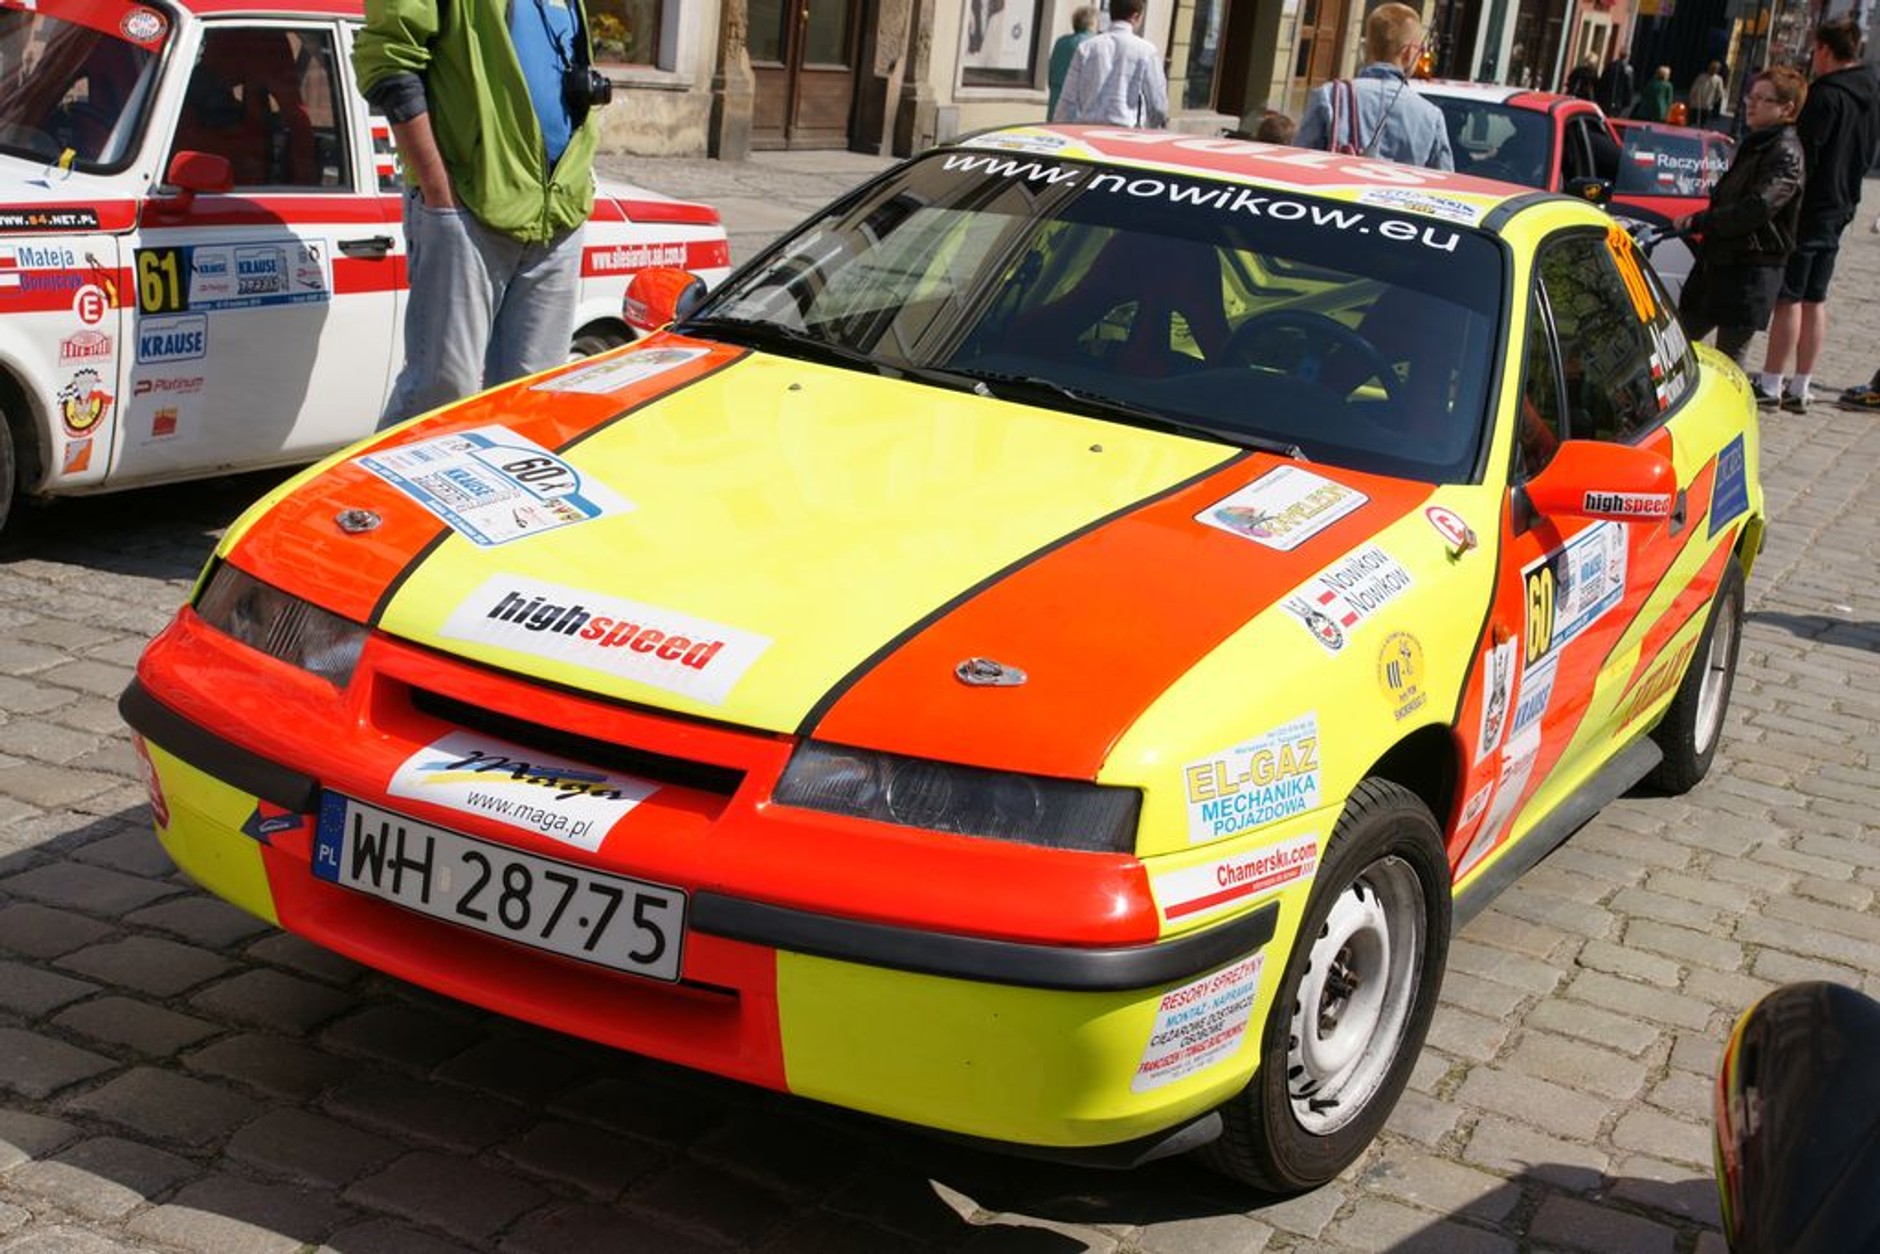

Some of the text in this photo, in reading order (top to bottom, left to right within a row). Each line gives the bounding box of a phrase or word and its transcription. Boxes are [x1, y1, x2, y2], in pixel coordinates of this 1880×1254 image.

[943, 153, 1460, 251] www.nowikow.eu
[18, 247, 75, 270] Mateja
[238, 258, 277, 275] KRAUSE
[139, 251, 179, 312] 61
[83, 296, 99, 320] E
[141, 332, 203, 357] KRAUSE
[153, 377, 204, 392] Platinum
[1319, 549, 1388, 594] Nowikow
[1344, 566, 1410, 617] Nowikow
[487, 591, 726, 670] highspeed
[1528, 567, 1553, 662] 60
[1186, 736, 1317, 803] EL-GAZ
[467, 790, 593, 838] www.maga.pl
[1202, 774, 1316, 822] MECHANIKA
[1214, 797, 1306, 835] POJAZDOWA
[319, 844, 337, 866] PL
[351, 812, 435, 904] WH
[1217, 842, 1317, 886] Chamerski.com
[1160, 983, 1208, 1012] RESORY
